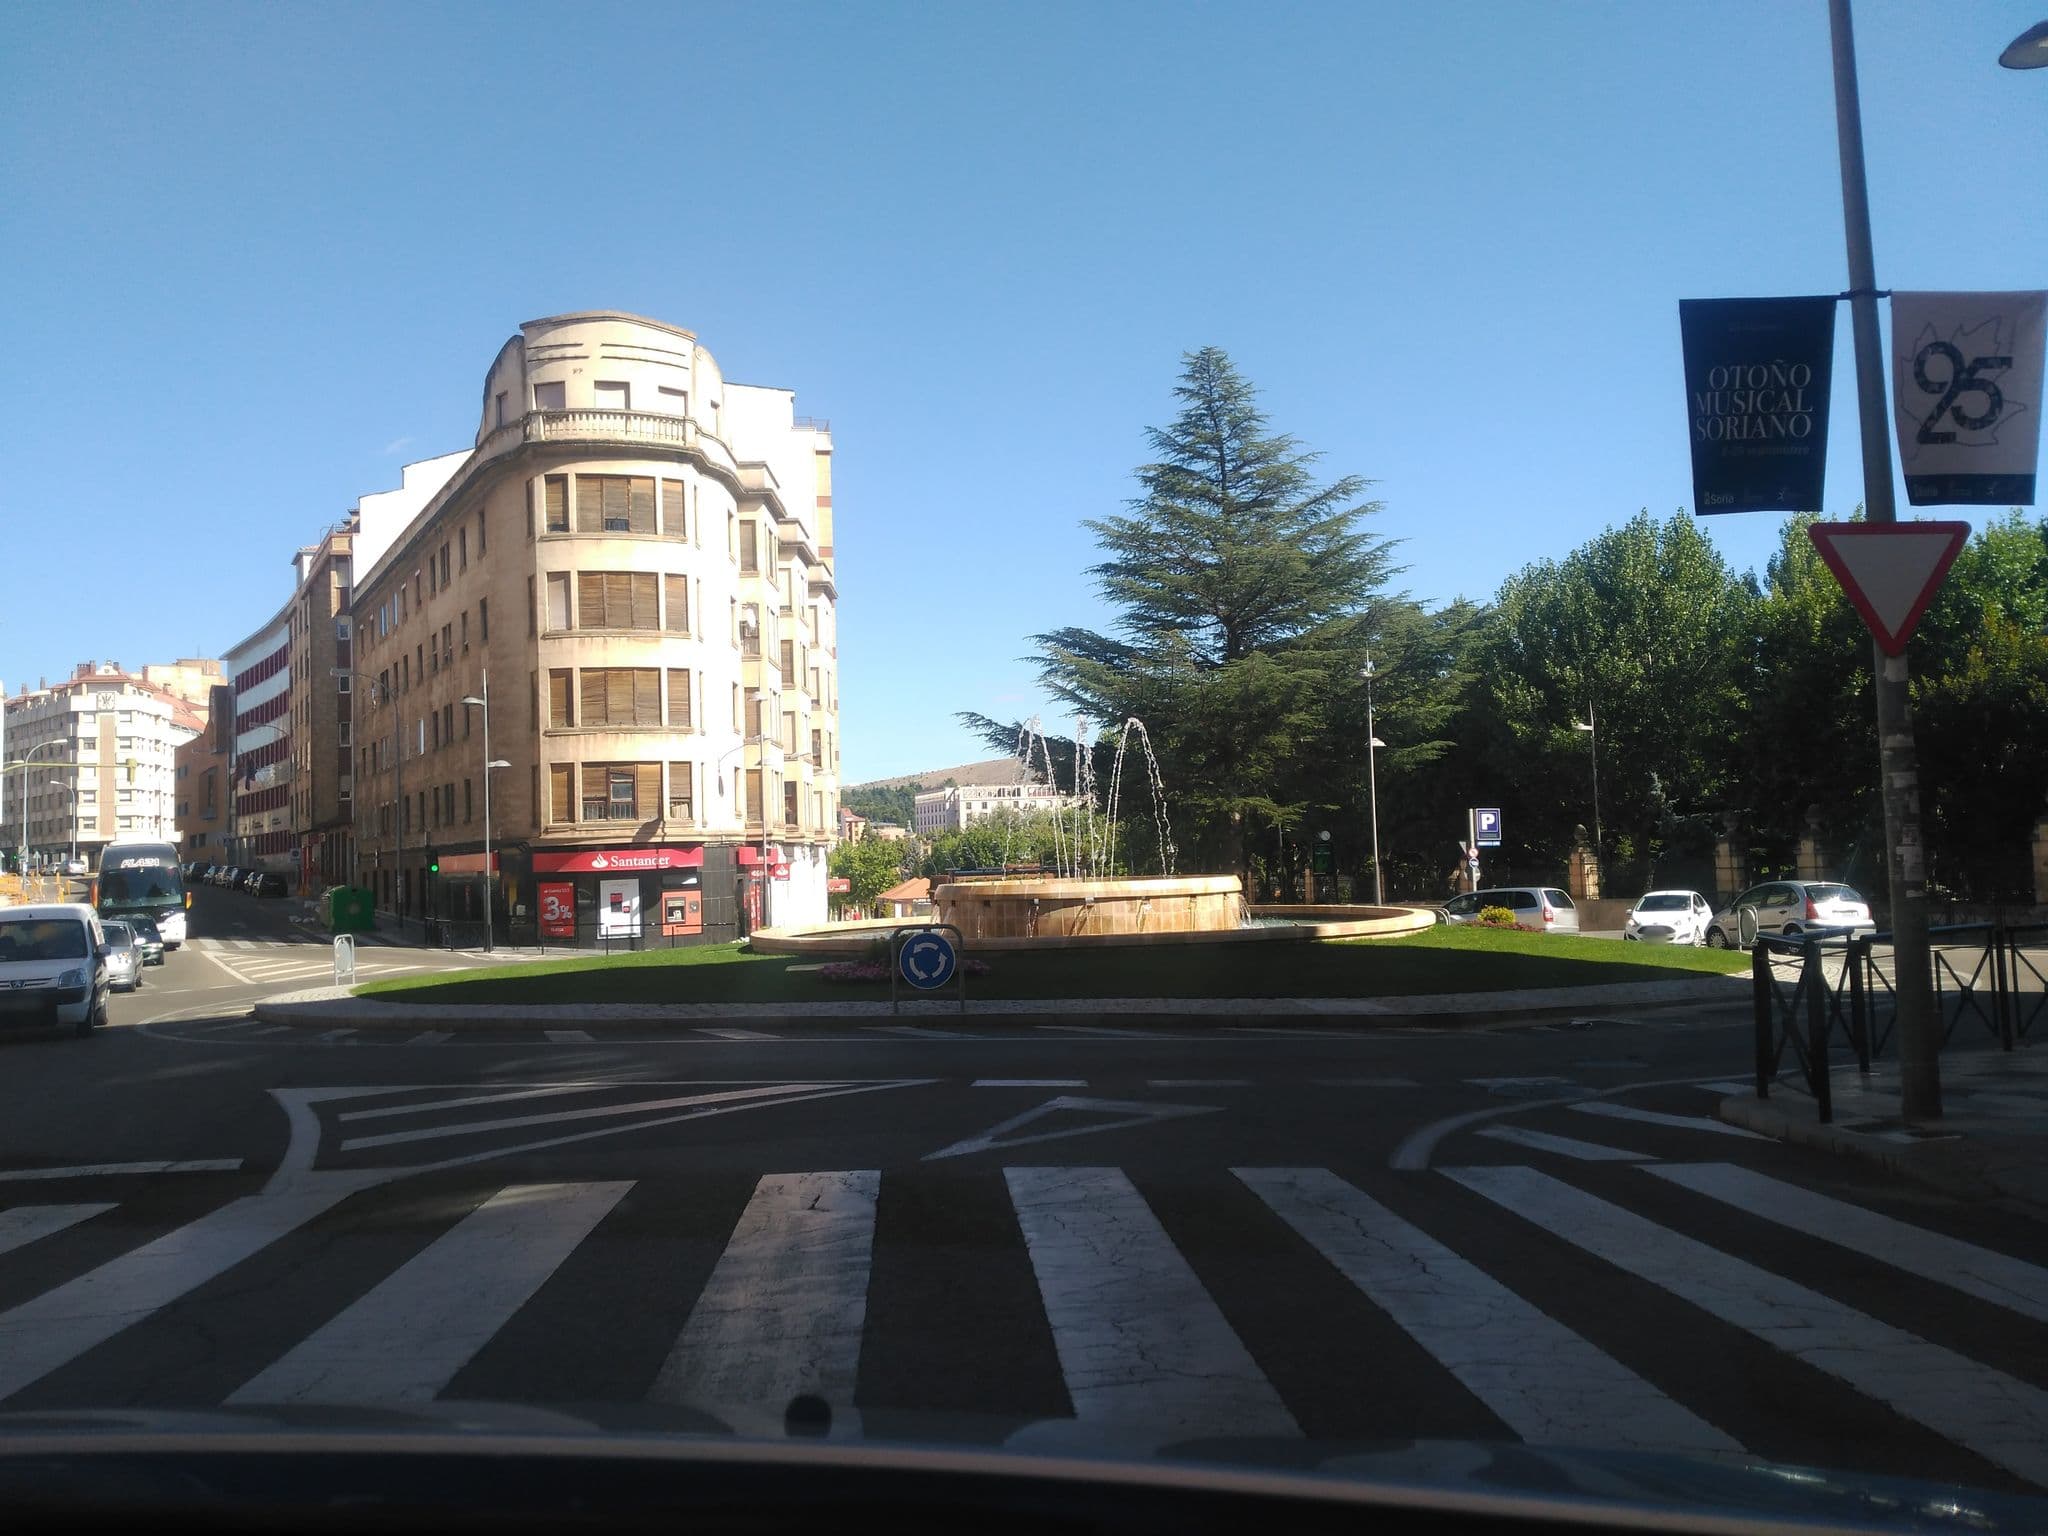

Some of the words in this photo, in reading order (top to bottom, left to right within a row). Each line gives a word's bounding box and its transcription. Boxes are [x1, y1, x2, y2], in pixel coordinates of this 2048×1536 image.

[1709, 359, 1812, 390] OTOÑO
[1695, 389, 1814, 416] MUSICAL
[1696, 413, 1812, 440] SORIANO
[1481, 813, 1496, 830] P
